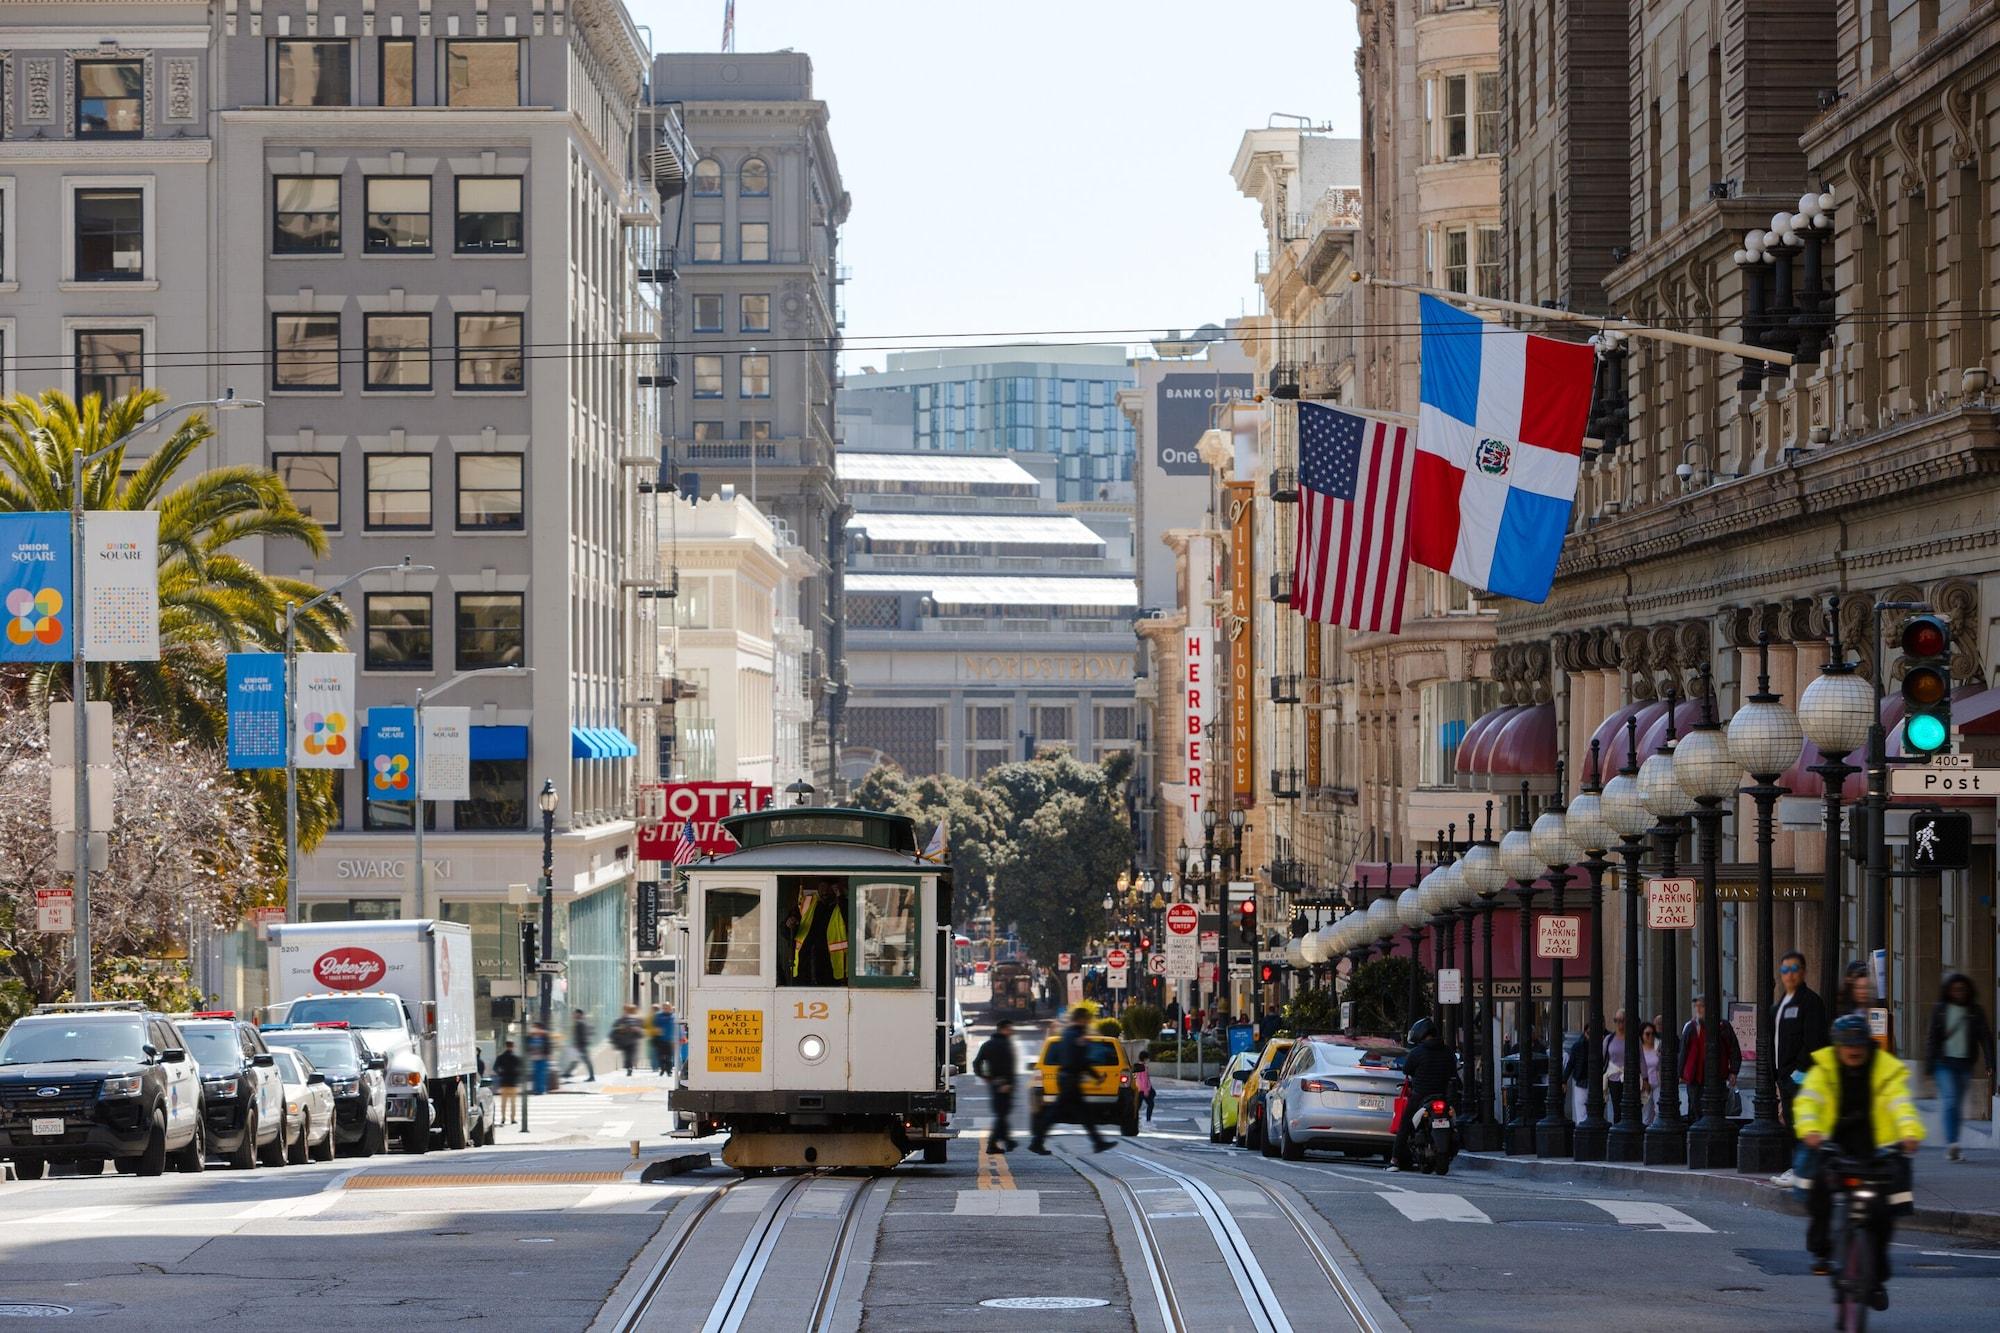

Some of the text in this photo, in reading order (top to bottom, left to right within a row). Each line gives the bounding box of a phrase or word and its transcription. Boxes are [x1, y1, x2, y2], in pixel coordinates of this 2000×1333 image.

[1166, 389, 1201, 398] BANK
[1204, 389, 1217, 398] O
[1162, 448, 1198, 463] One
[18, 543, 49, 551] UNION
[11, 551, 56, 563] SQUARE
[99, 551, 143, 561] SQUARE
[1229, 498, 1253, 611] VILLA
[964, 655, 1128, 679] NORDSTROM
[238, 684, 272, 692] SQUARE
[308, 684, 342, 692] SQUARE
[1229, 615, 1249, 784] FLORENCE
[1188, 637, 1201, 813] HERBERT
[1935, 756, 1958, 766] 400
[1925, 775, 1980, 789] Post
[1663, 883, 1680, 893] NO
[1651, 893, 1692, 903] PARKING
[1659, 906, 1685, 914] TAXI
[647, 886, 656, 945] ART GALLERY
[1656, 916, 1688, 924] ZONE
[1552, 920, 1566, 928] NO
[1541, 928, 1576, 937] PARKING
[319, 957, 380, 981] Doherty's
[1495, 984, 1542, 994] FRANIS
[793, 1001, 830, 1020] 12
[710, 1046, 722, 1055] BAY
[735, 1046, 760, 1054] TAYLOR
